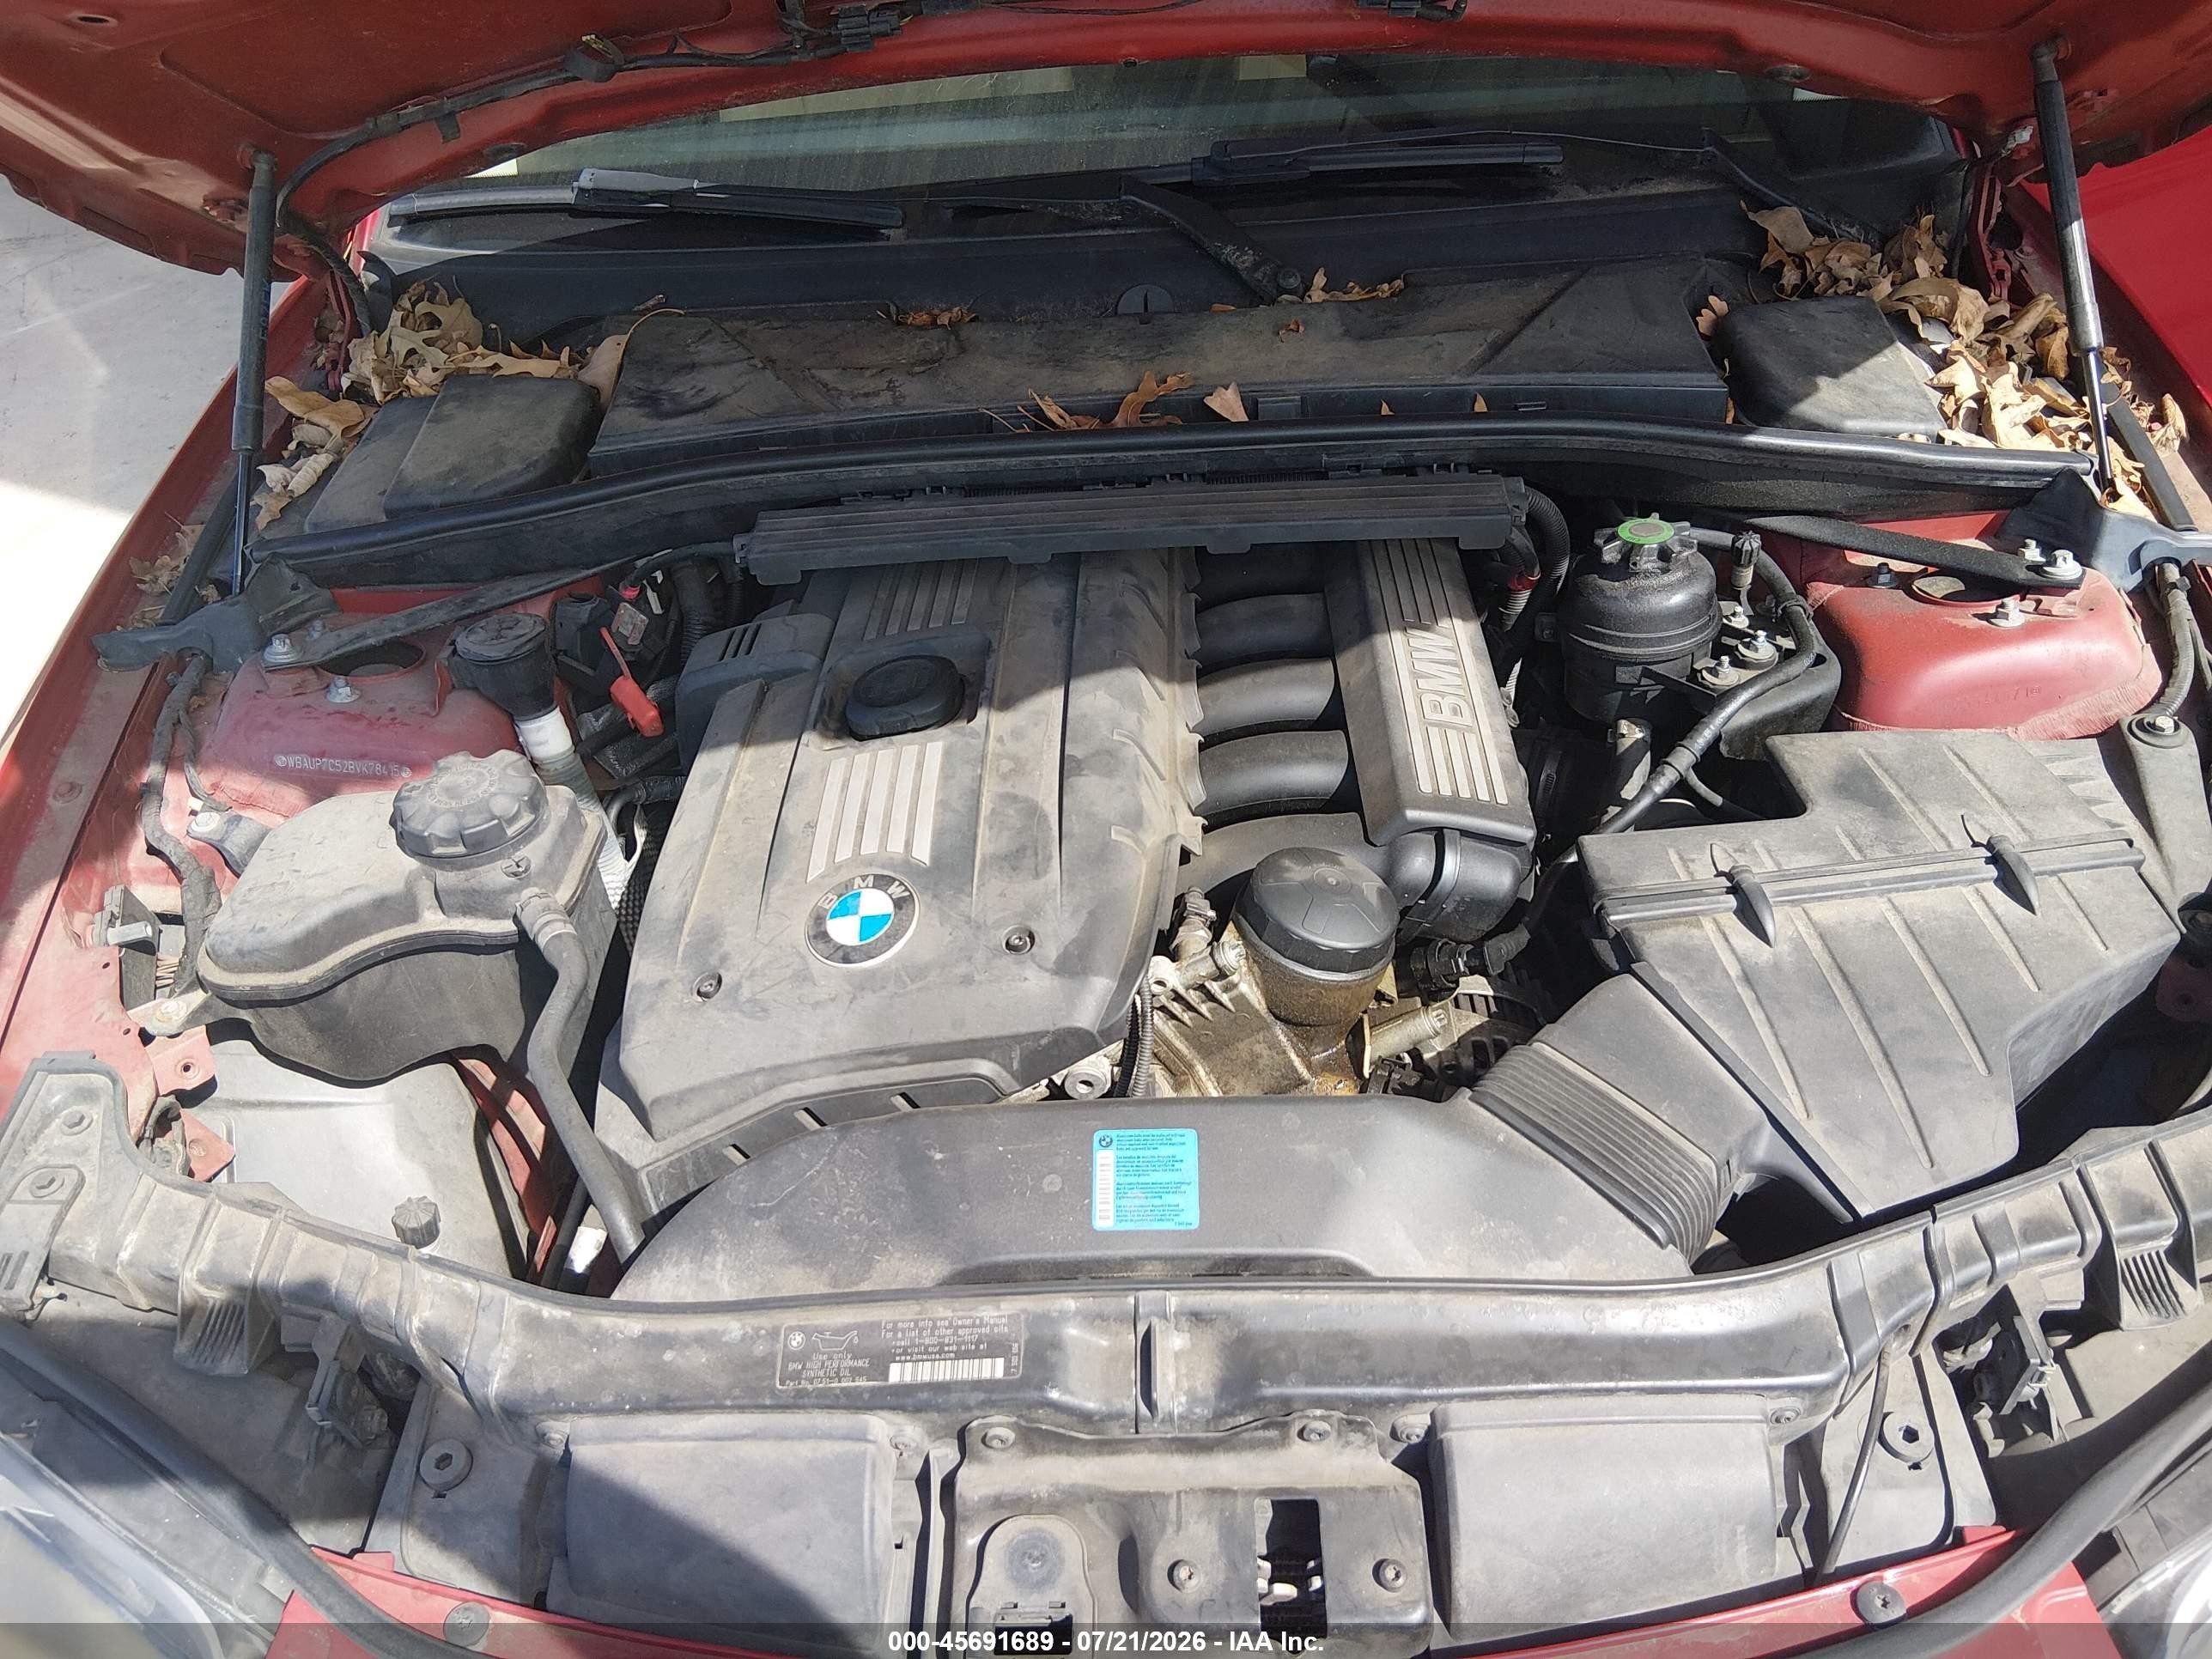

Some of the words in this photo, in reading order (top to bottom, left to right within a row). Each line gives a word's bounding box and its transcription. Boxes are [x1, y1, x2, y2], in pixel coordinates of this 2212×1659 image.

[1405, 626, 1474, 727] BMW
[817, 874, 911, 909] BMW
[881, 1320, 893, 1329] For
[918, 1318, 933, 1328] info
[983, 1314, 1008, 1325] Manual
[881, 1329, 893, 1339] For
[906, 1328, 918, 1338] list
[922, 1327, 932, 1337] of
[934, 1326, 954, 1336] other
[958, 1325, 989, 1336] approved
[908, 1345, 925, 1354] visit
[944, 1343, 957, 1352] web
[961, 1342, 976, 1351] site
[979, 1341, 988, 1351] at
[812, 1352, 829, 1360] Use
[832, 1351, 854, 1360] only
[895, 1352, 956, 1362] www.bmwusa.com
[788, 1361, 804, 1371] BMW
[806, 1360, 822, 1370] HIGH
[824, 1358, 872, 1369] PERFORMANCE
[803, 1369, 838, 1378] SYNTHETIC
[840, 1367, 851, 1376] OIL
